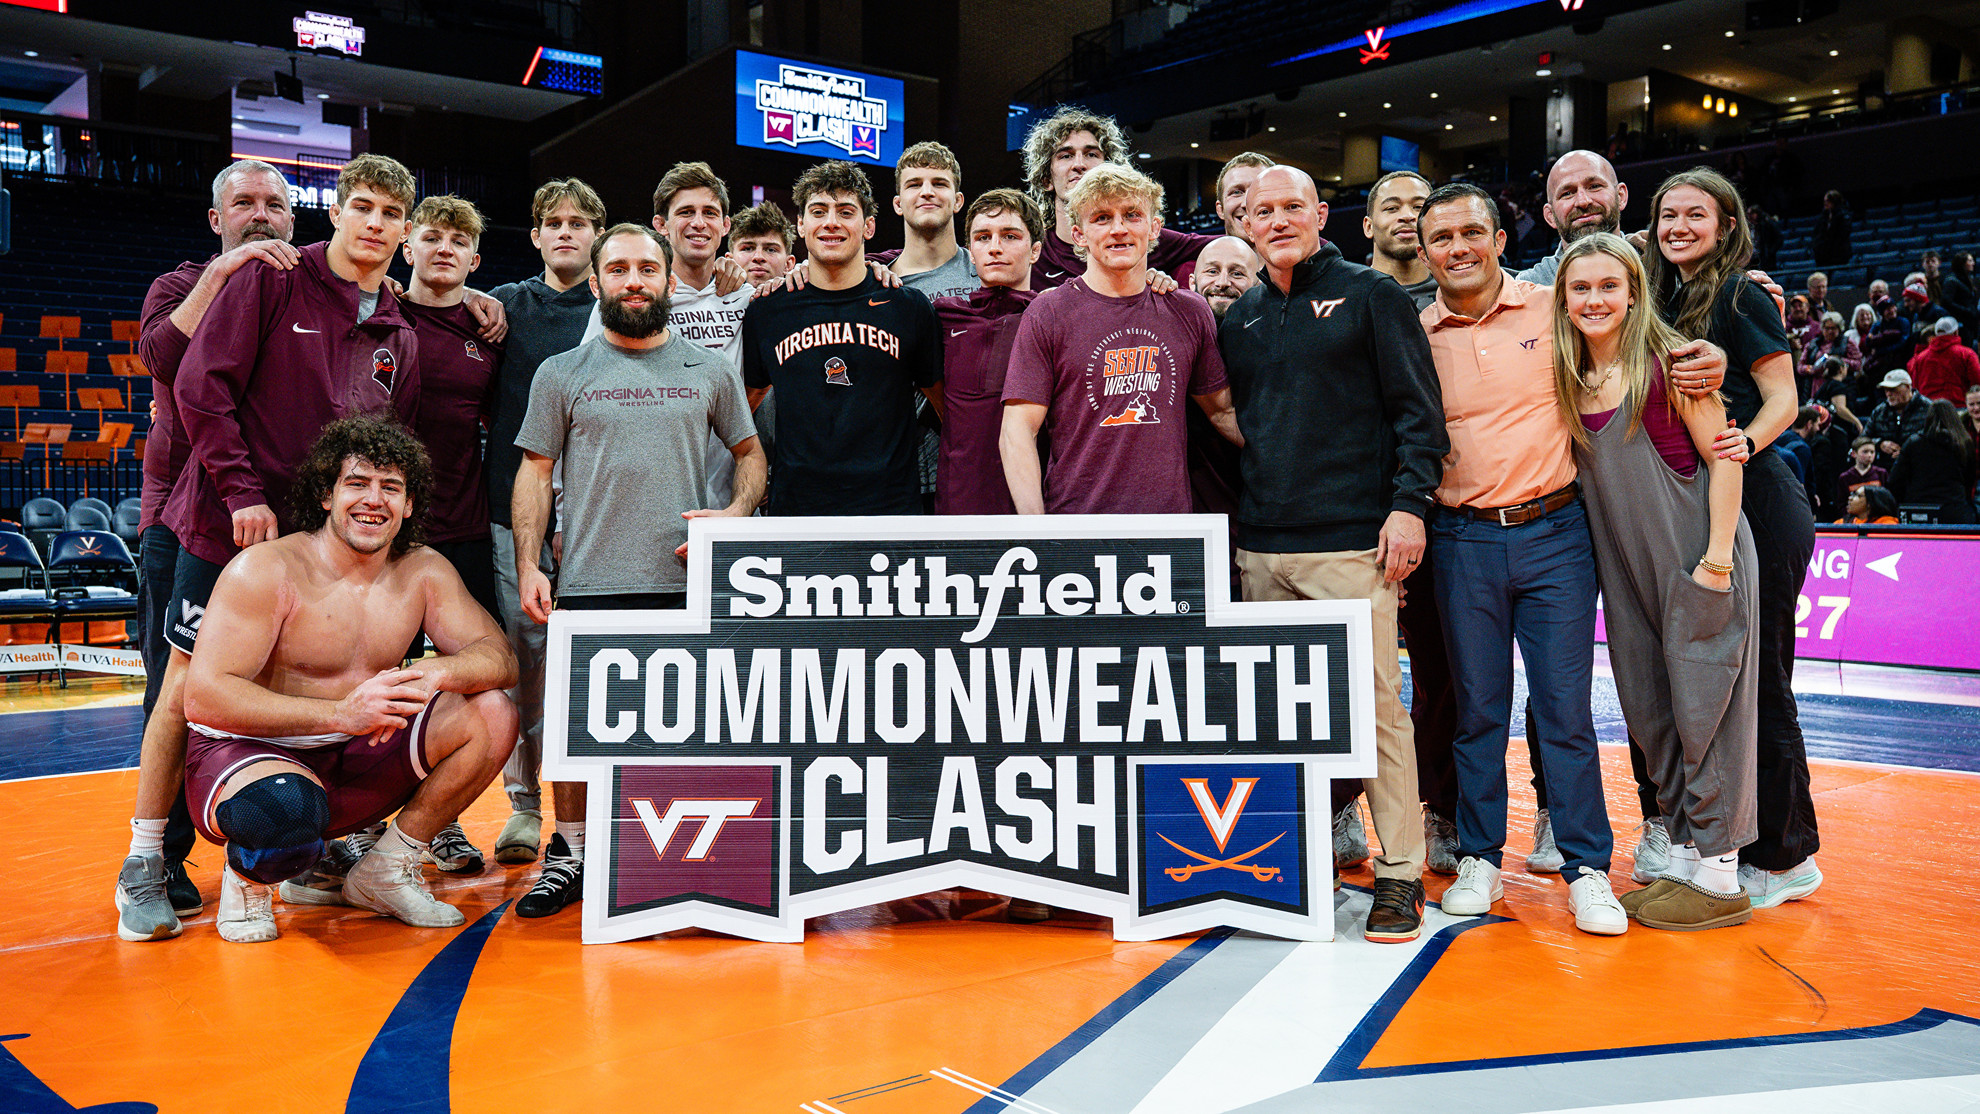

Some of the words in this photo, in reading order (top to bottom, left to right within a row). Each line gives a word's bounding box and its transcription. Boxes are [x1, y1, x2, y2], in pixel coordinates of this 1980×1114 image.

[761, 84, 883, 126] COMMONWEALTH
[768, 115, 792, 132] VT
[797, 112, 850, 145] CLASH
[666, 310, 716, 326] RGINIA
[1310, 297, 1346, 319] VT
[680, 325, 735, 340] HOKIES
[774, 322, 855, 366] VIRGINIA
[856, 322, 900, 360] TECH
[1126, 327, 1159, 342] REGIONAL
[1519, 338, 1539, 350] VT
[1103, 346, 1160, 378] SERTC
[583, 387, 655, 403] VIRGINIA
[656, 387, 700, 400] TECH
[1103, 373, 1161, 397] WRESTLING
[587, 644, 1331, 744] COMMONWEALTH
[628, 797, 763, 862] VT
[803, 755, 1117, 877] CLASH
[1179, 777, 1261, 855] V
